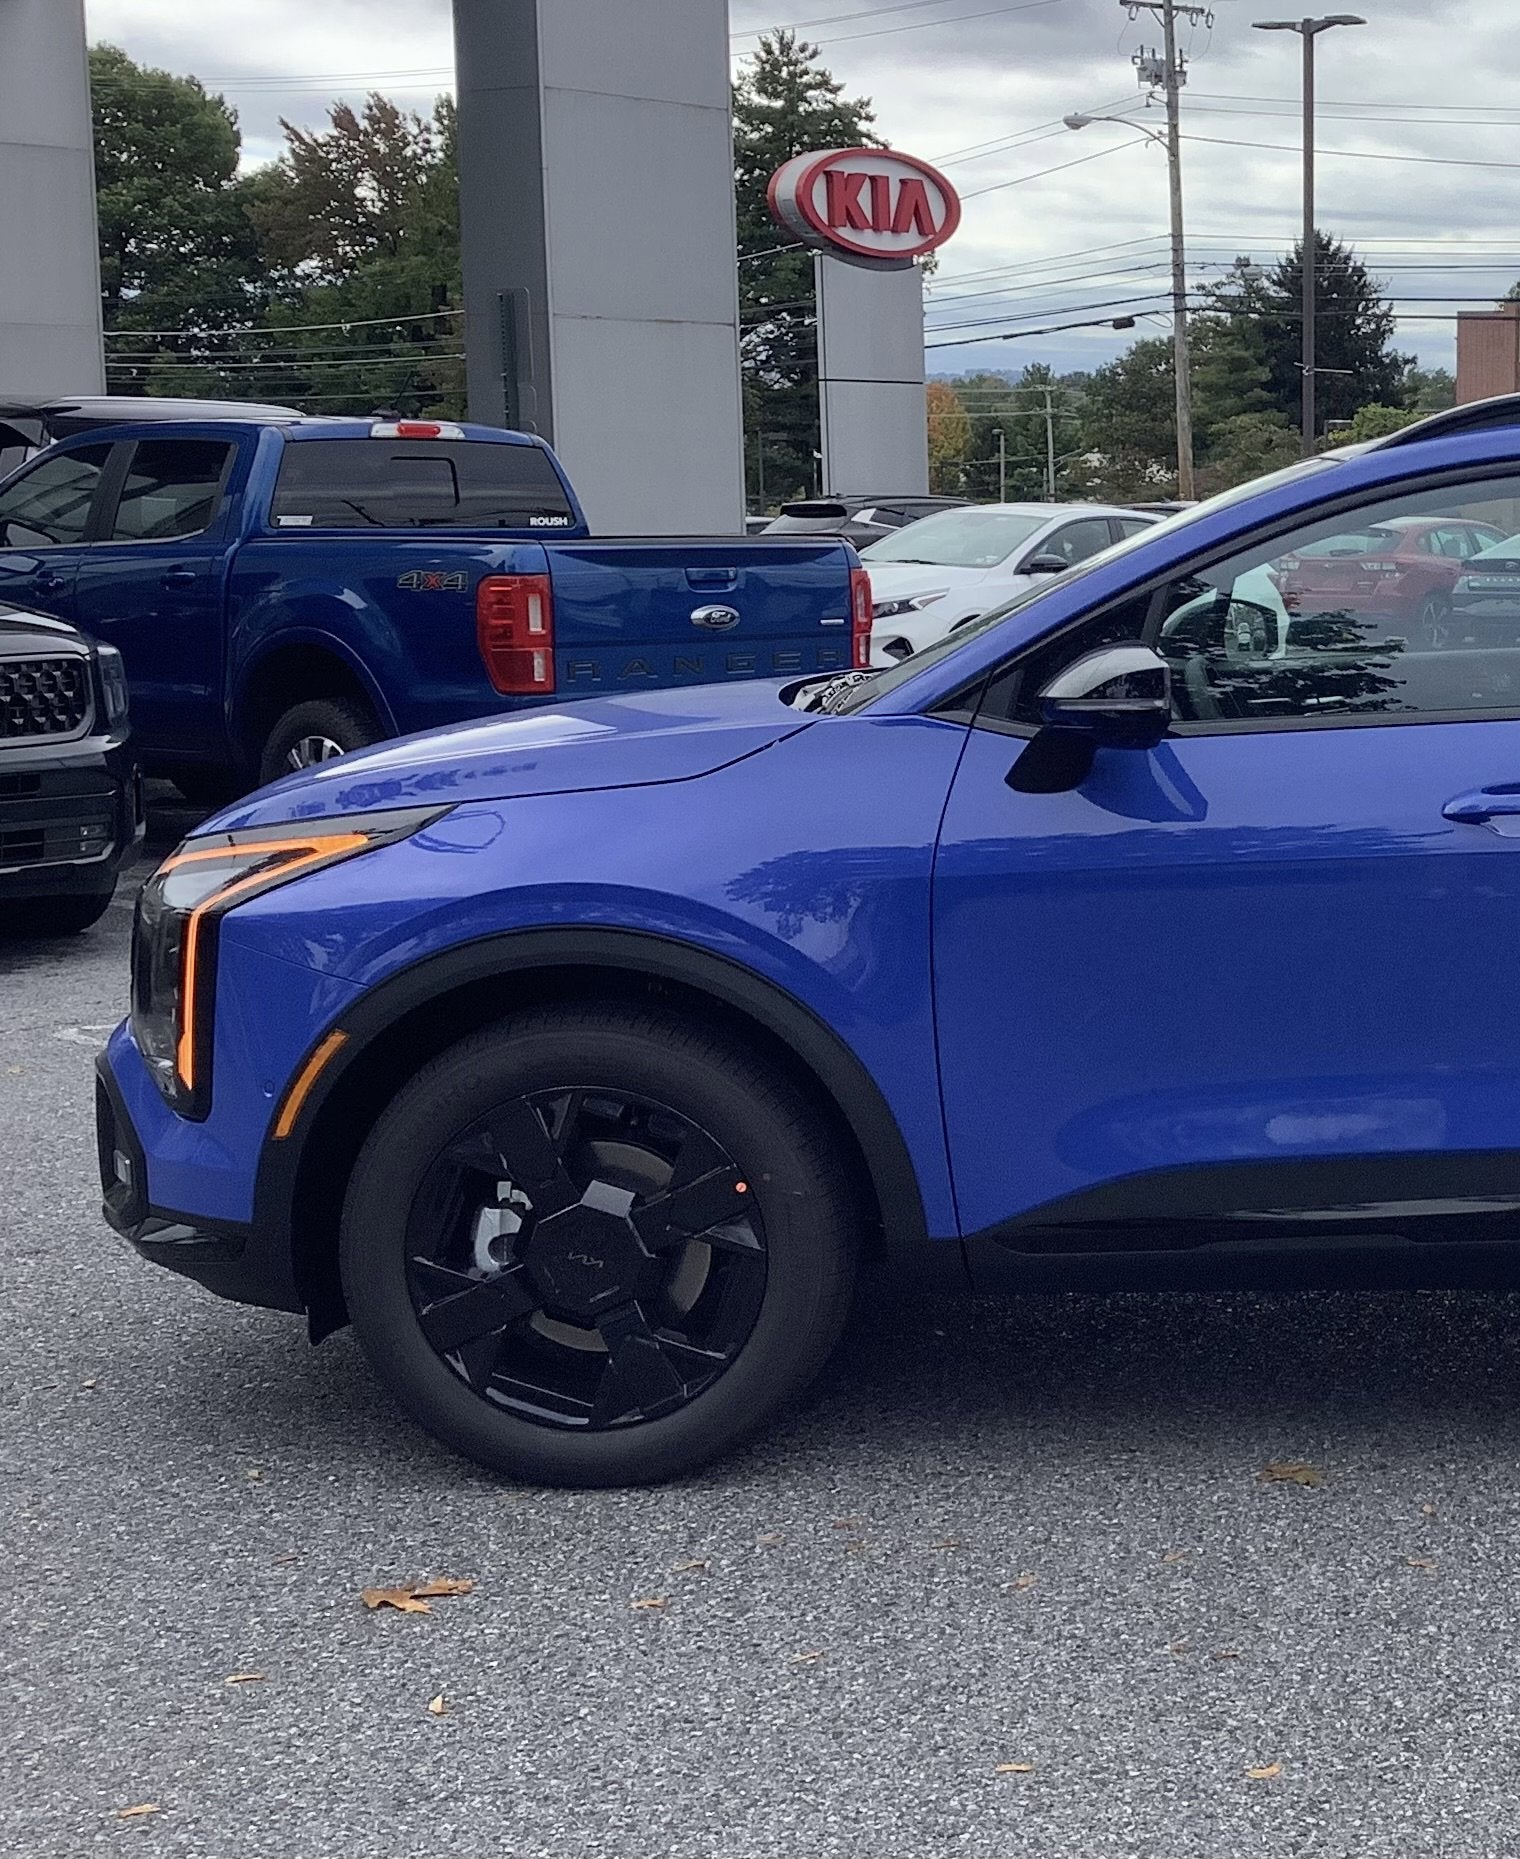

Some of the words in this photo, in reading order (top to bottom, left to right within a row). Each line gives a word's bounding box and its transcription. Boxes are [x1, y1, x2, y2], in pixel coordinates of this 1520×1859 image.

[824, 170, 937, 237] KIA
[530, 516, 568, 526] ROUSH
[567, 650, 844, 682] RANGER
